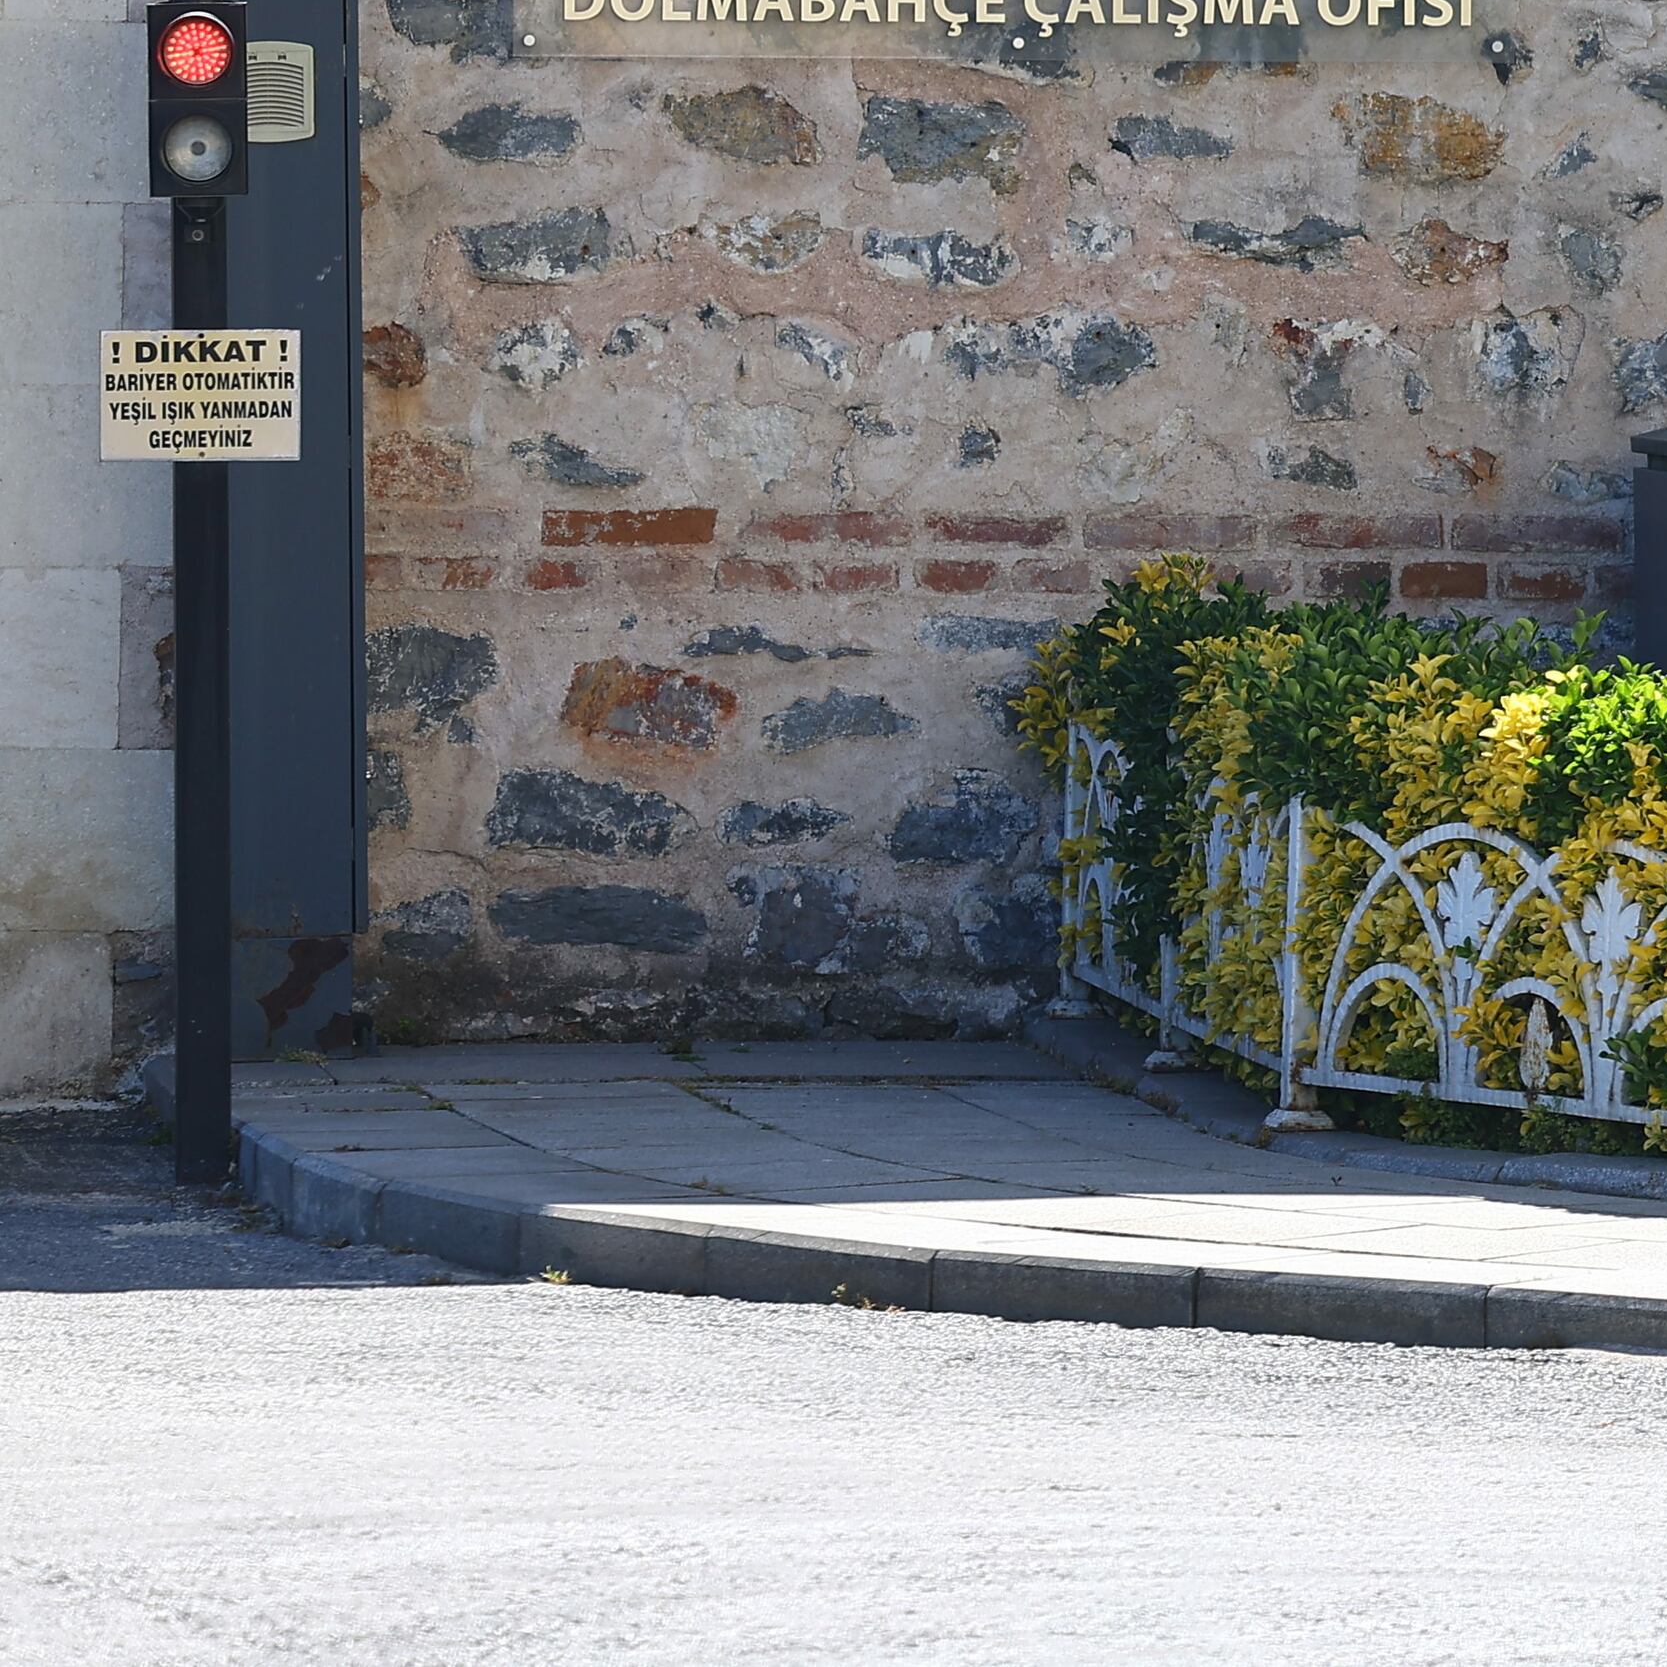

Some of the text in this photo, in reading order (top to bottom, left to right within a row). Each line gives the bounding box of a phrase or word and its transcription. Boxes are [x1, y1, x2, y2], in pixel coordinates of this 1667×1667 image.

[135, 335, 267, 363] DİKKAT
[105, 367, 296, 391] BARİYER OTOMATİKTİR
[109, 397, 292, 425] YEŞİL IŞIK YANMADAN
[149, 425, 252, 453] GEÇMEYİNİZ
